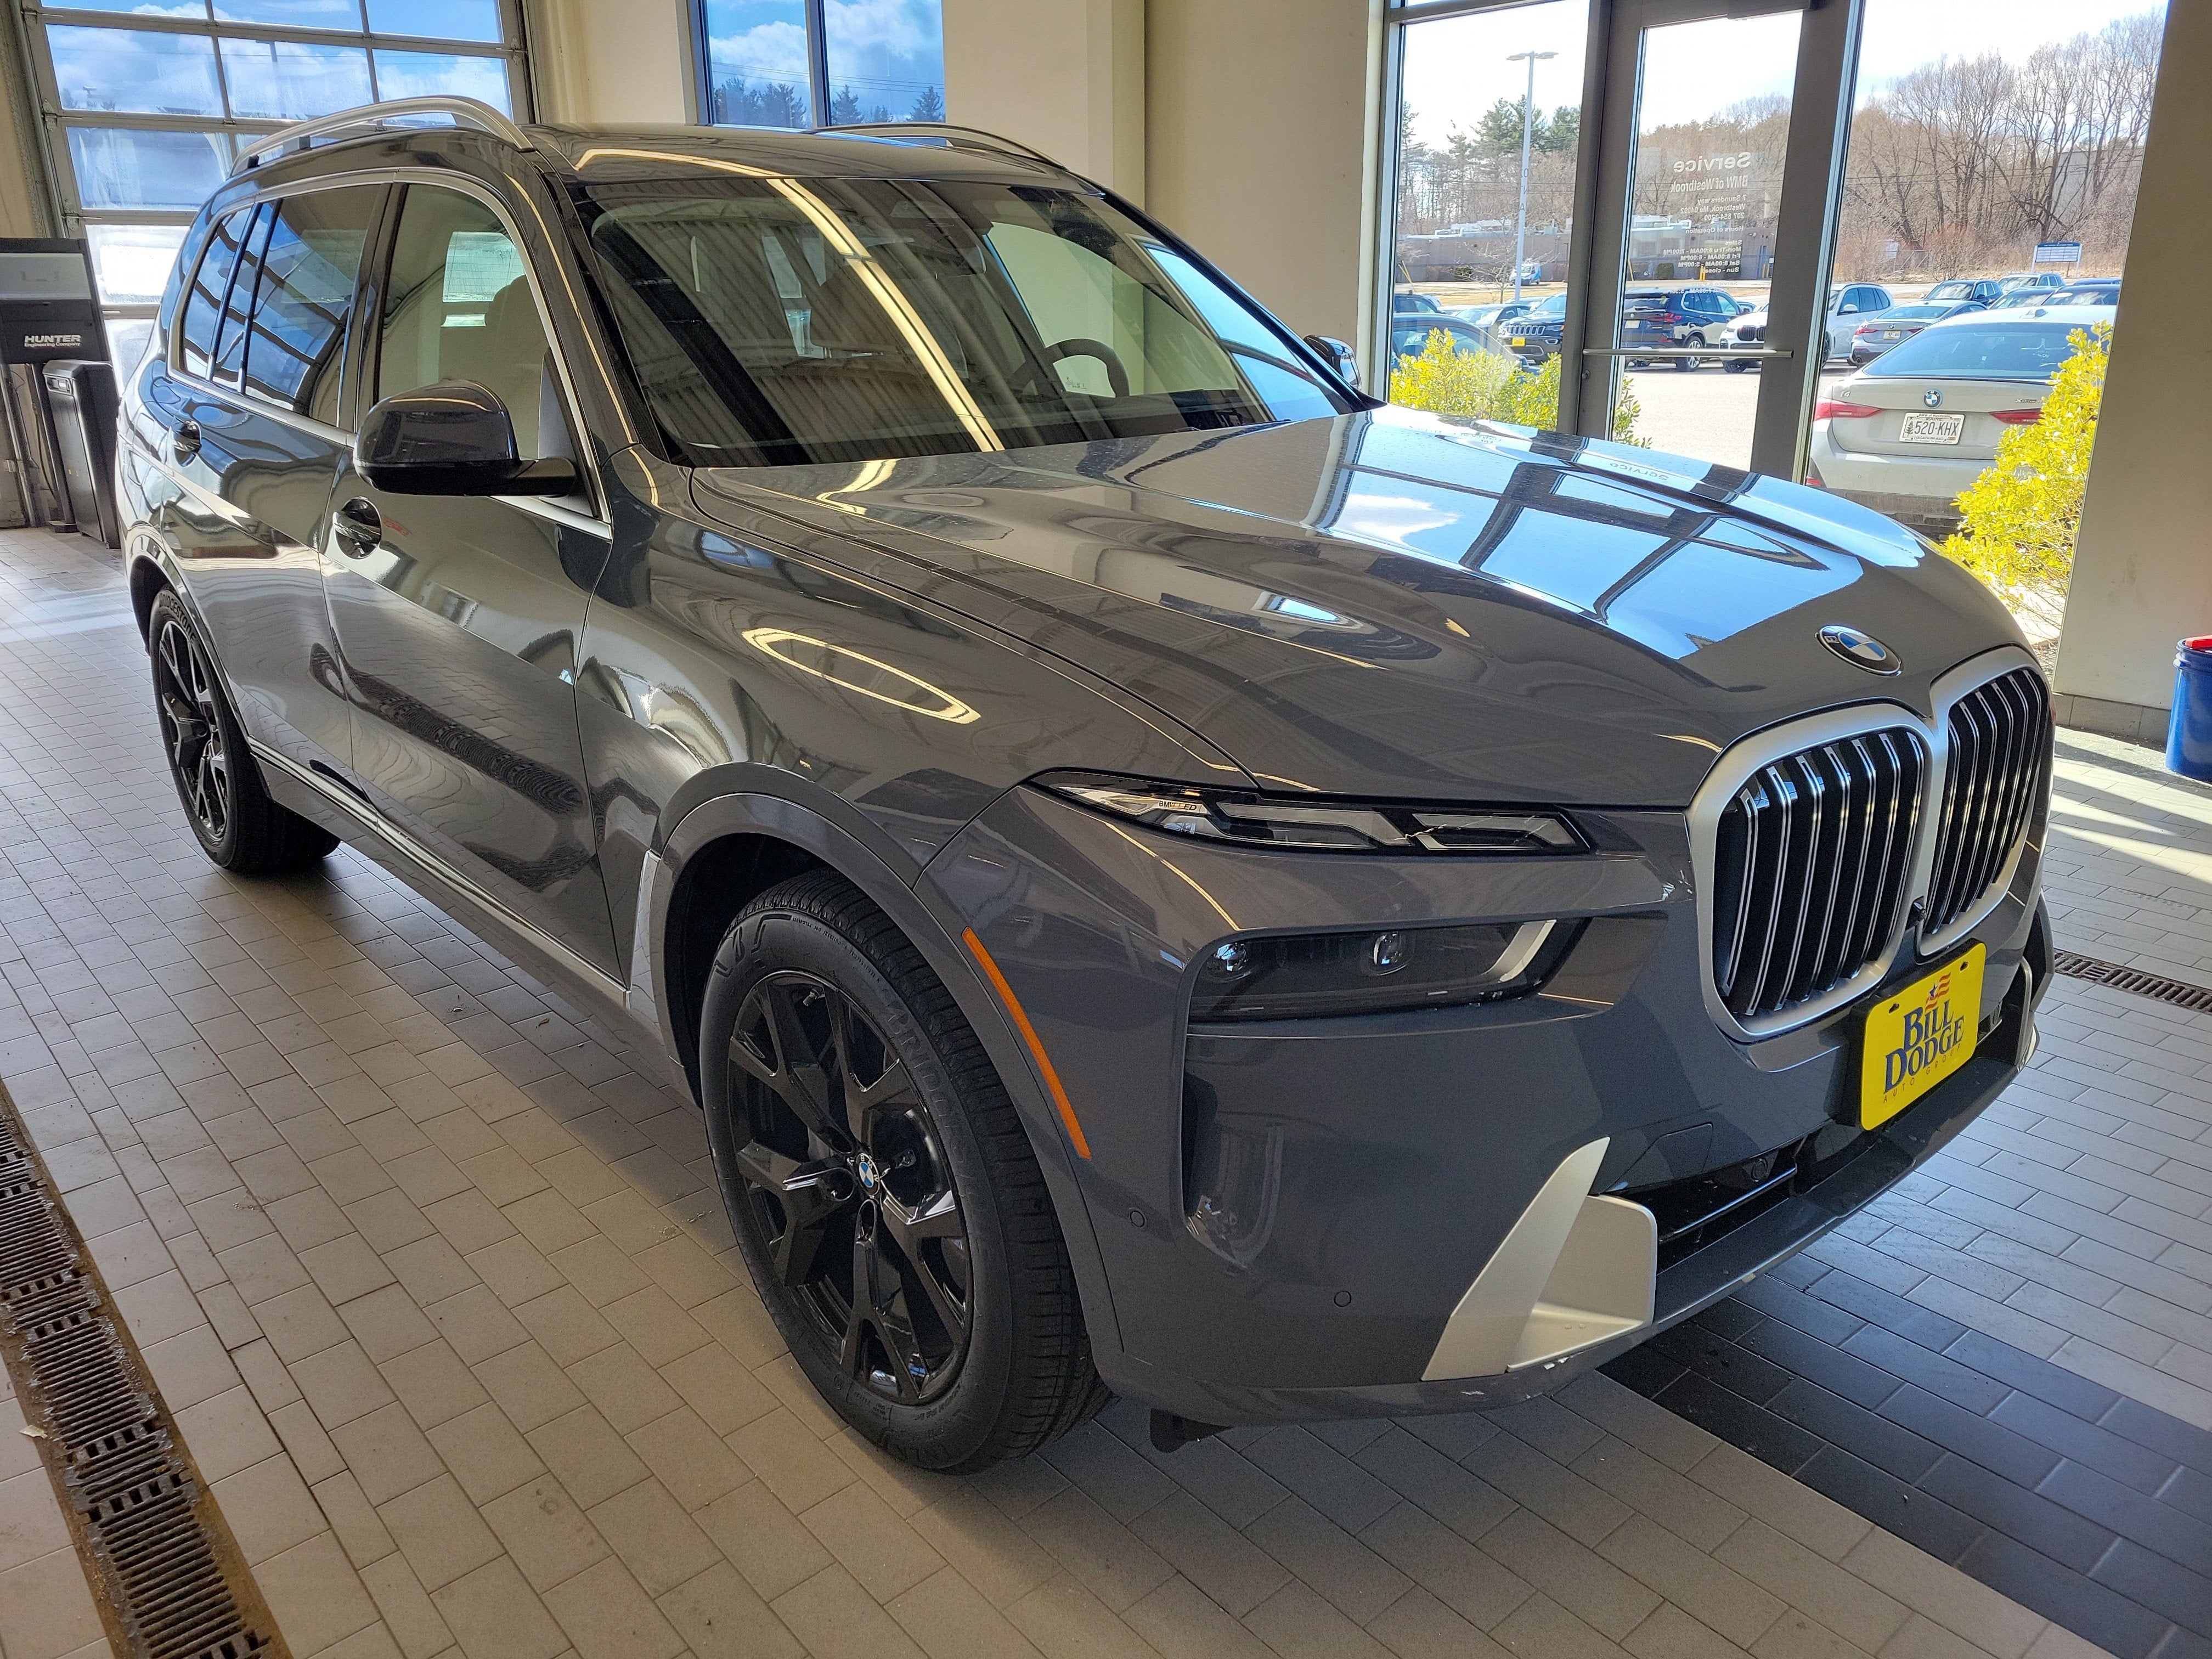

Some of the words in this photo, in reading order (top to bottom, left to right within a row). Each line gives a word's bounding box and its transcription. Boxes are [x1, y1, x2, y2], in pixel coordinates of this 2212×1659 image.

[25, 335, 81, 343] HUNTER
[1903, 998, 1954, 1051] BILL
[1883, 1015, 1965, 1095] DODGE
[1883, 1077, 1915, 1104] AUTO
[1926, 1043, 1962, 1075] GROUP
